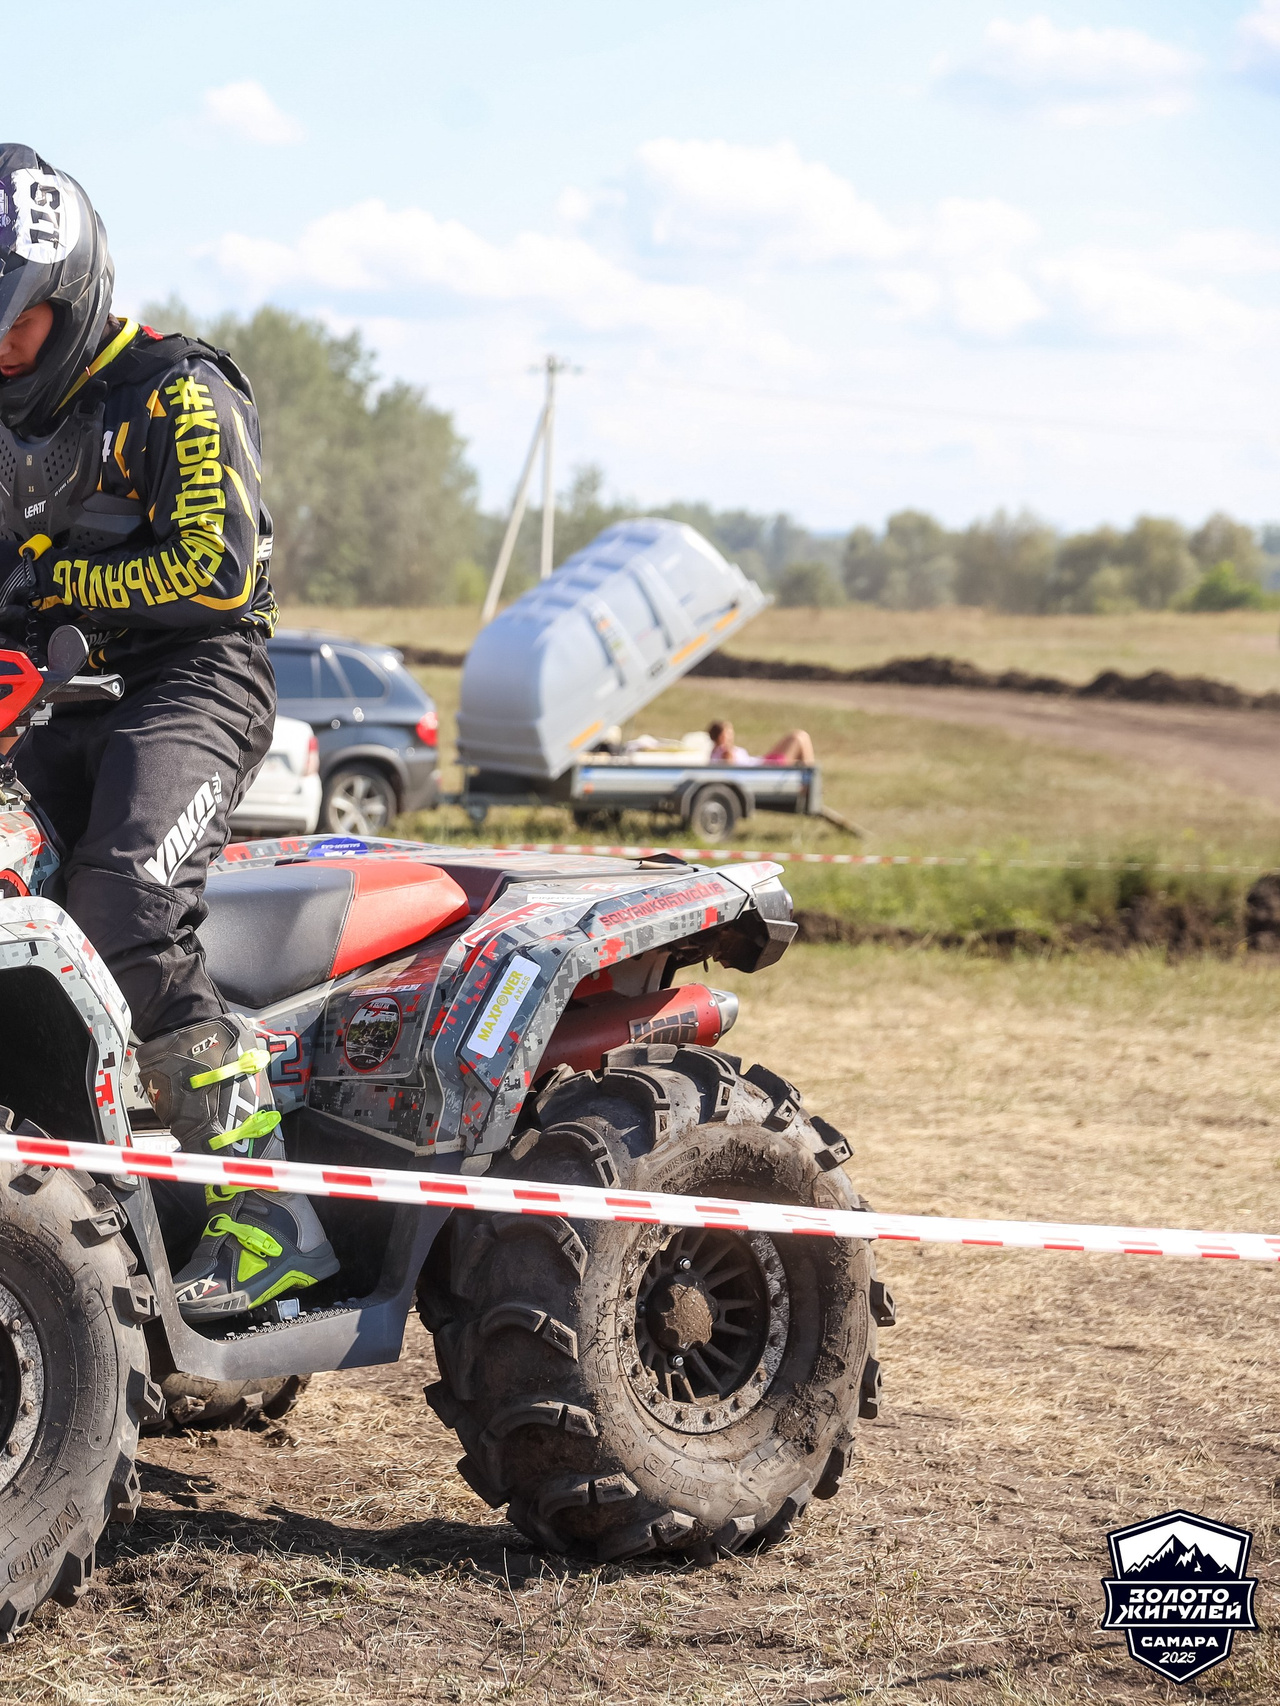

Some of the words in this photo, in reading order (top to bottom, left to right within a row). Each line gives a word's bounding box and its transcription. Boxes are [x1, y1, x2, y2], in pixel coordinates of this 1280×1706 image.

[24, 500, 47, 519] LEATT
[143, 781, 218, 887] YOKO
[514, 976, 531, 1004] AXLES
[477, 970, 524, 1042] MAXPOWER
[191, 1033, 220, 1058] GTX
[176, 1273, 220, 1302] TX
[7, 1500, 83, 1584] MUD
